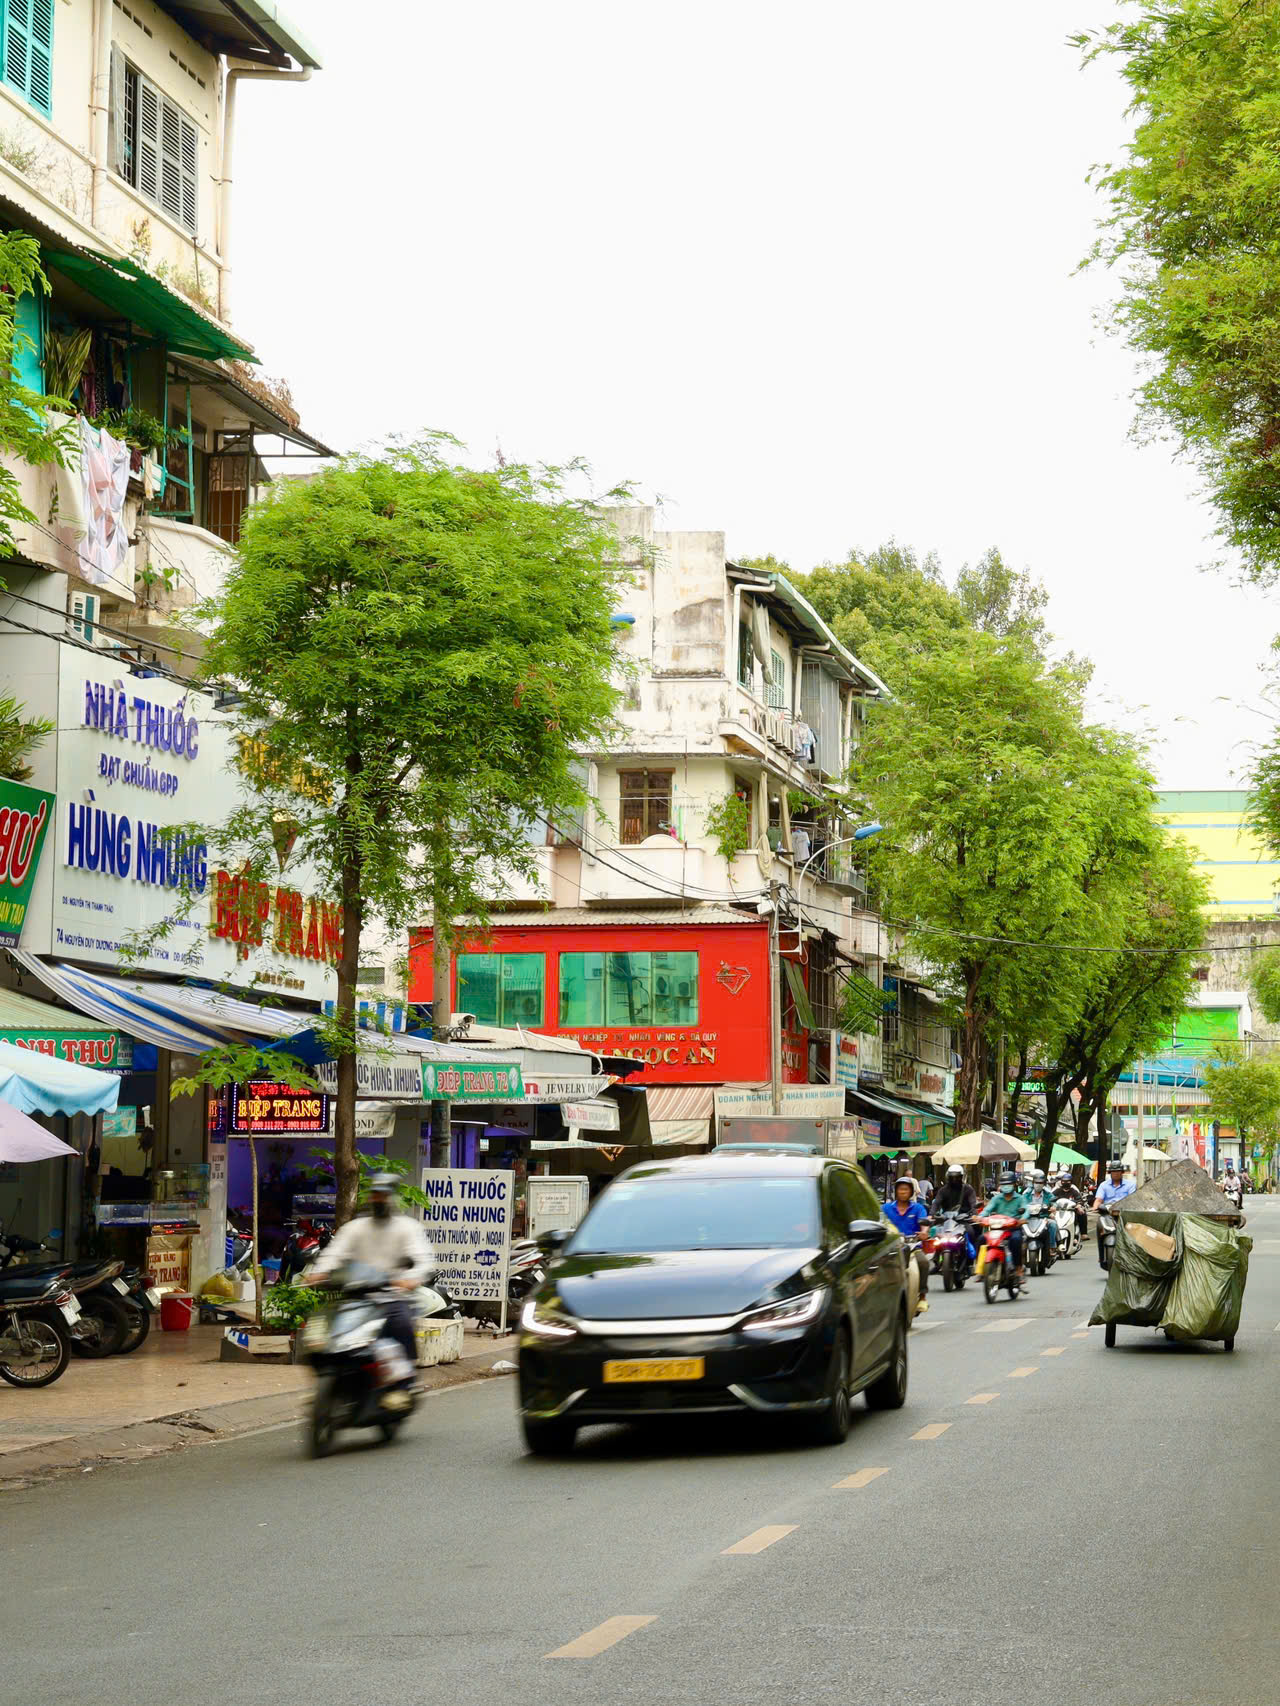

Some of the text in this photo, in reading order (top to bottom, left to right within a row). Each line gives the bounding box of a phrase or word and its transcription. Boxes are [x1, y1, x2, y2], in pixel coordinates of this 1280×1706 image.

[83, 678, 199, 761] NHÀ THUỐC
[99, 752, 179, 797] ĐẠT CHUẨN GPP
[66, 788, 208, 896] HÙNG NHUNG
[56, 928, 64, 944] 74
[62, 1035, 116, 1065] THƯ
[545, 1083, 586, 1095] JEWELRY
[273, 1099, 321, 1118] TRANG
[425, 1175, 507, 1201] NHÀ THUỐC
[423, 1200, 506, 1224] HÙNG NHUNG
[448, 1225, 469, 1245] THUỐC
[470, 1226, 481, 1248] NỘI
[486, 1230, 505, 1249] NGOẠI
[460, 1252, 471, 1263] ÁP
[462, 1288, 481, 1297] 672
[482, 1288, 500, 1298] 271
